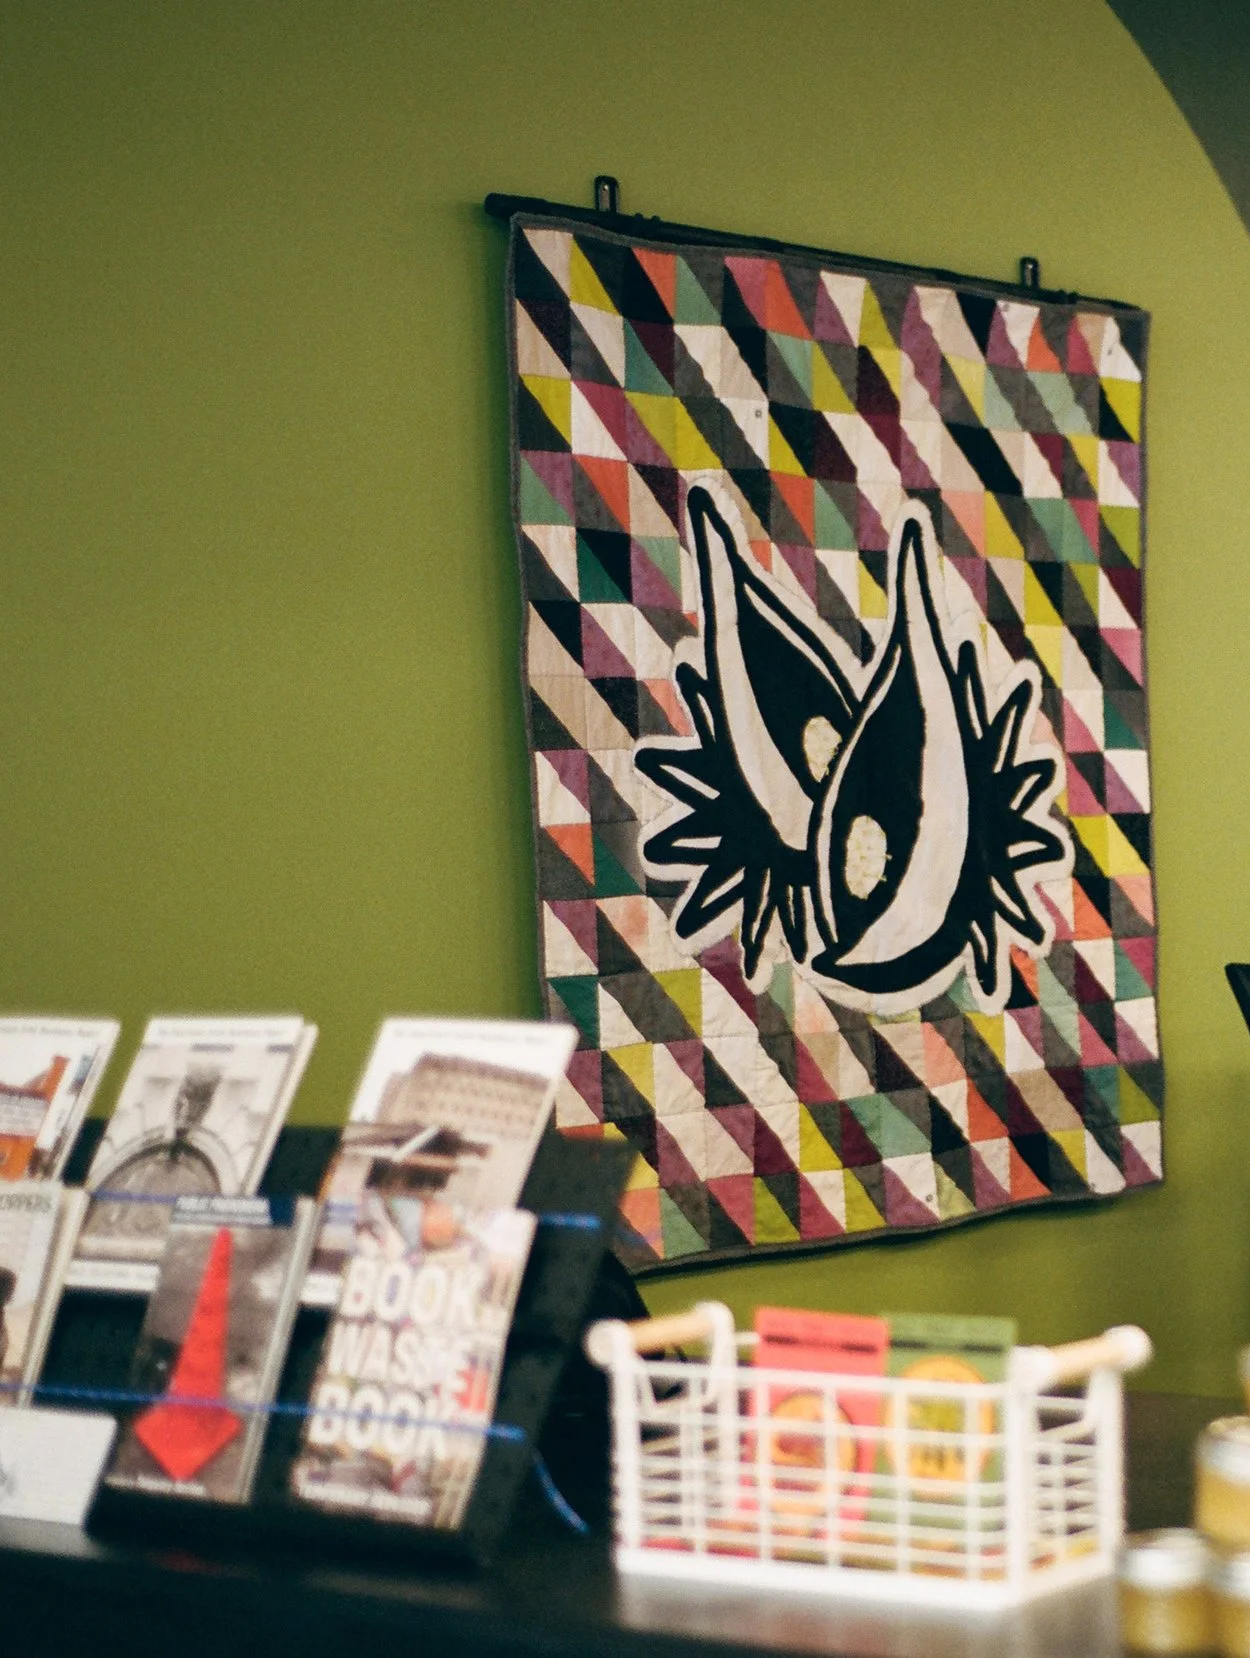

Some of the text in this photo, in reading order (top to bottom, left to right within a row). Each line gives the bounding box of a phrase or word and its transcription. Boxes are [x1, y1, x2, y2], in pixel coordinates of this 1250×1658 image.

[340, 1258, 483, 1328] BOOK
[328, 1321, 473, 1392] WASTE
[308, 1382, 458, 1460] BOOK
